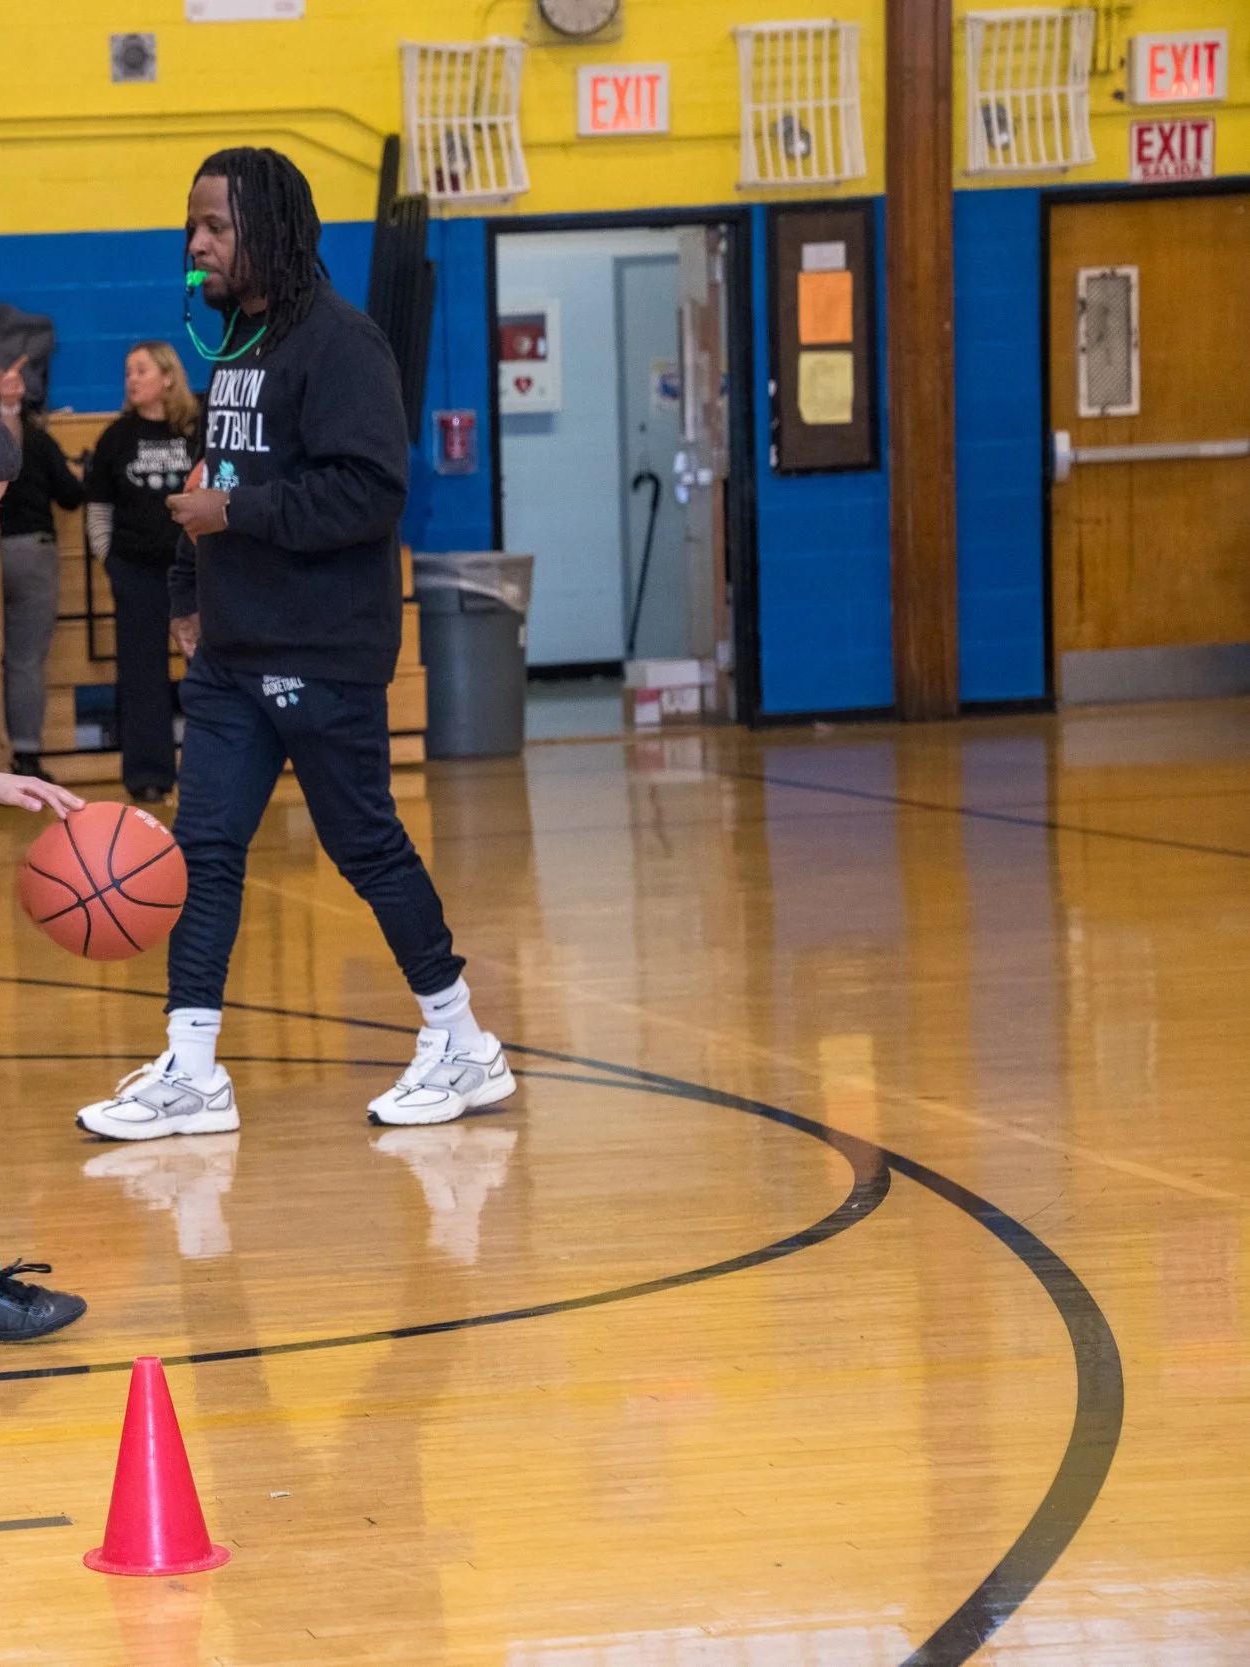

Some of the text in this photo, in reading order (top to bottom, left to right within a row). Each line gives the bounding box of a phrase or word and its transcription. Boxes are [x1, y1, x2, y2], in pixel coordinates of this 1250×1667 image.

[1147, 41, 1221, 99] EXIT
[590, 74, 661, 131] EXIT
[1136, 122, 1208, 164] EXIT
